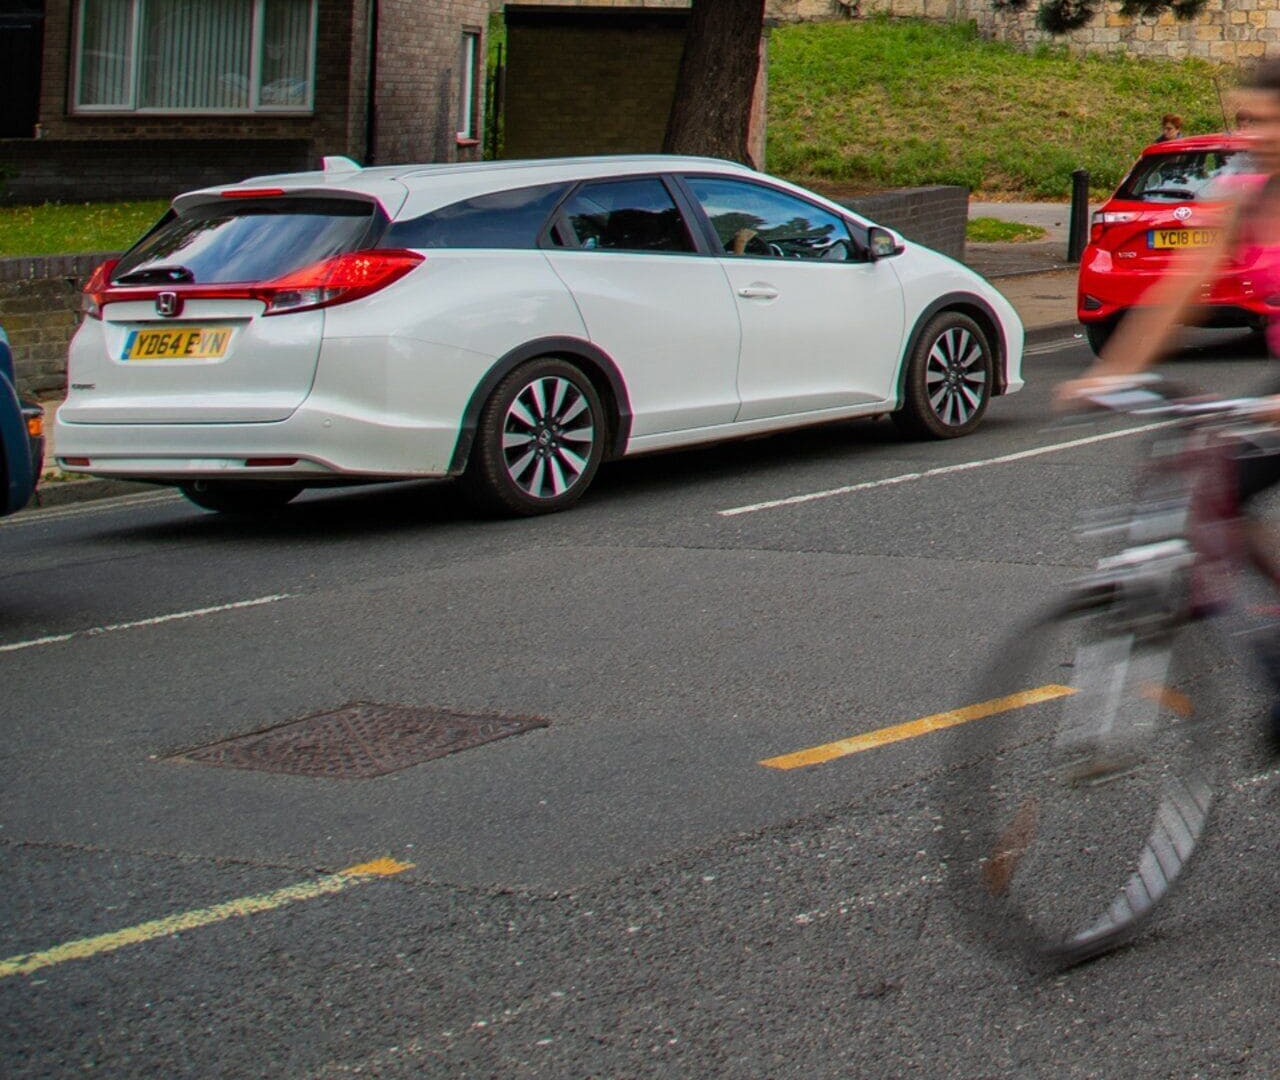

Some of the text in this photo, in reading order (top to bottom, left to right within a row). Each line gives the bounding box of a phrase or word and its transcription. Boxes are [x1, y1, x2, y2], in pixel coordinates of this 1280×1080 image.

[1160, 231, 1217, 246] YC18 CDX
[136, 333, 182, 355] YD64
